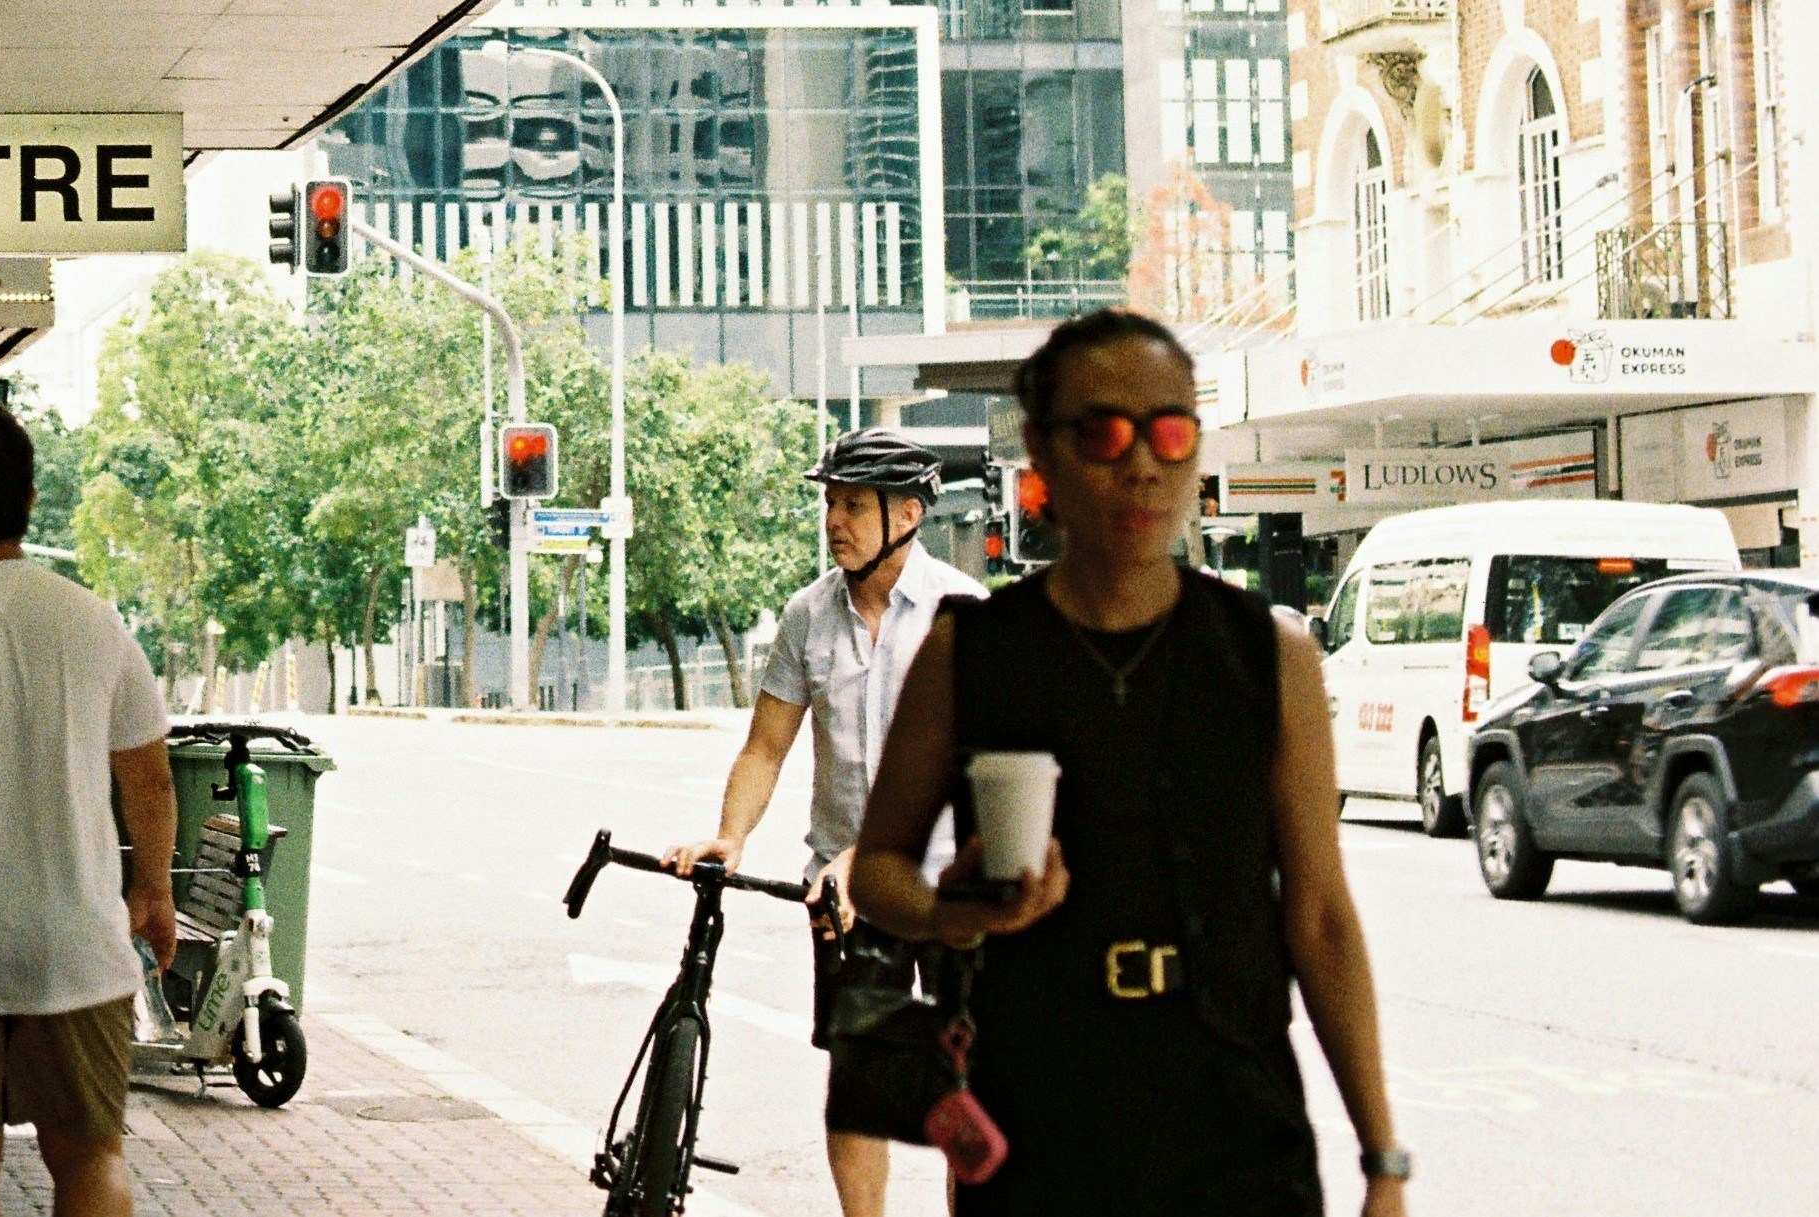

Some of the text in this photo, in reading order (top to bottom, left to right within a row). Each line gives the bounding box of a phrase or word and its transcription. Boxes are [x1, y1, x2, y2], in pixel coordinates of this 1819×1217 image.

[1621, 346, 1685, 359] OKUMAN
[1621, 363, 1686, 375] EXPRESS
[1363, 463, 1497, 490] LUDLOWS
